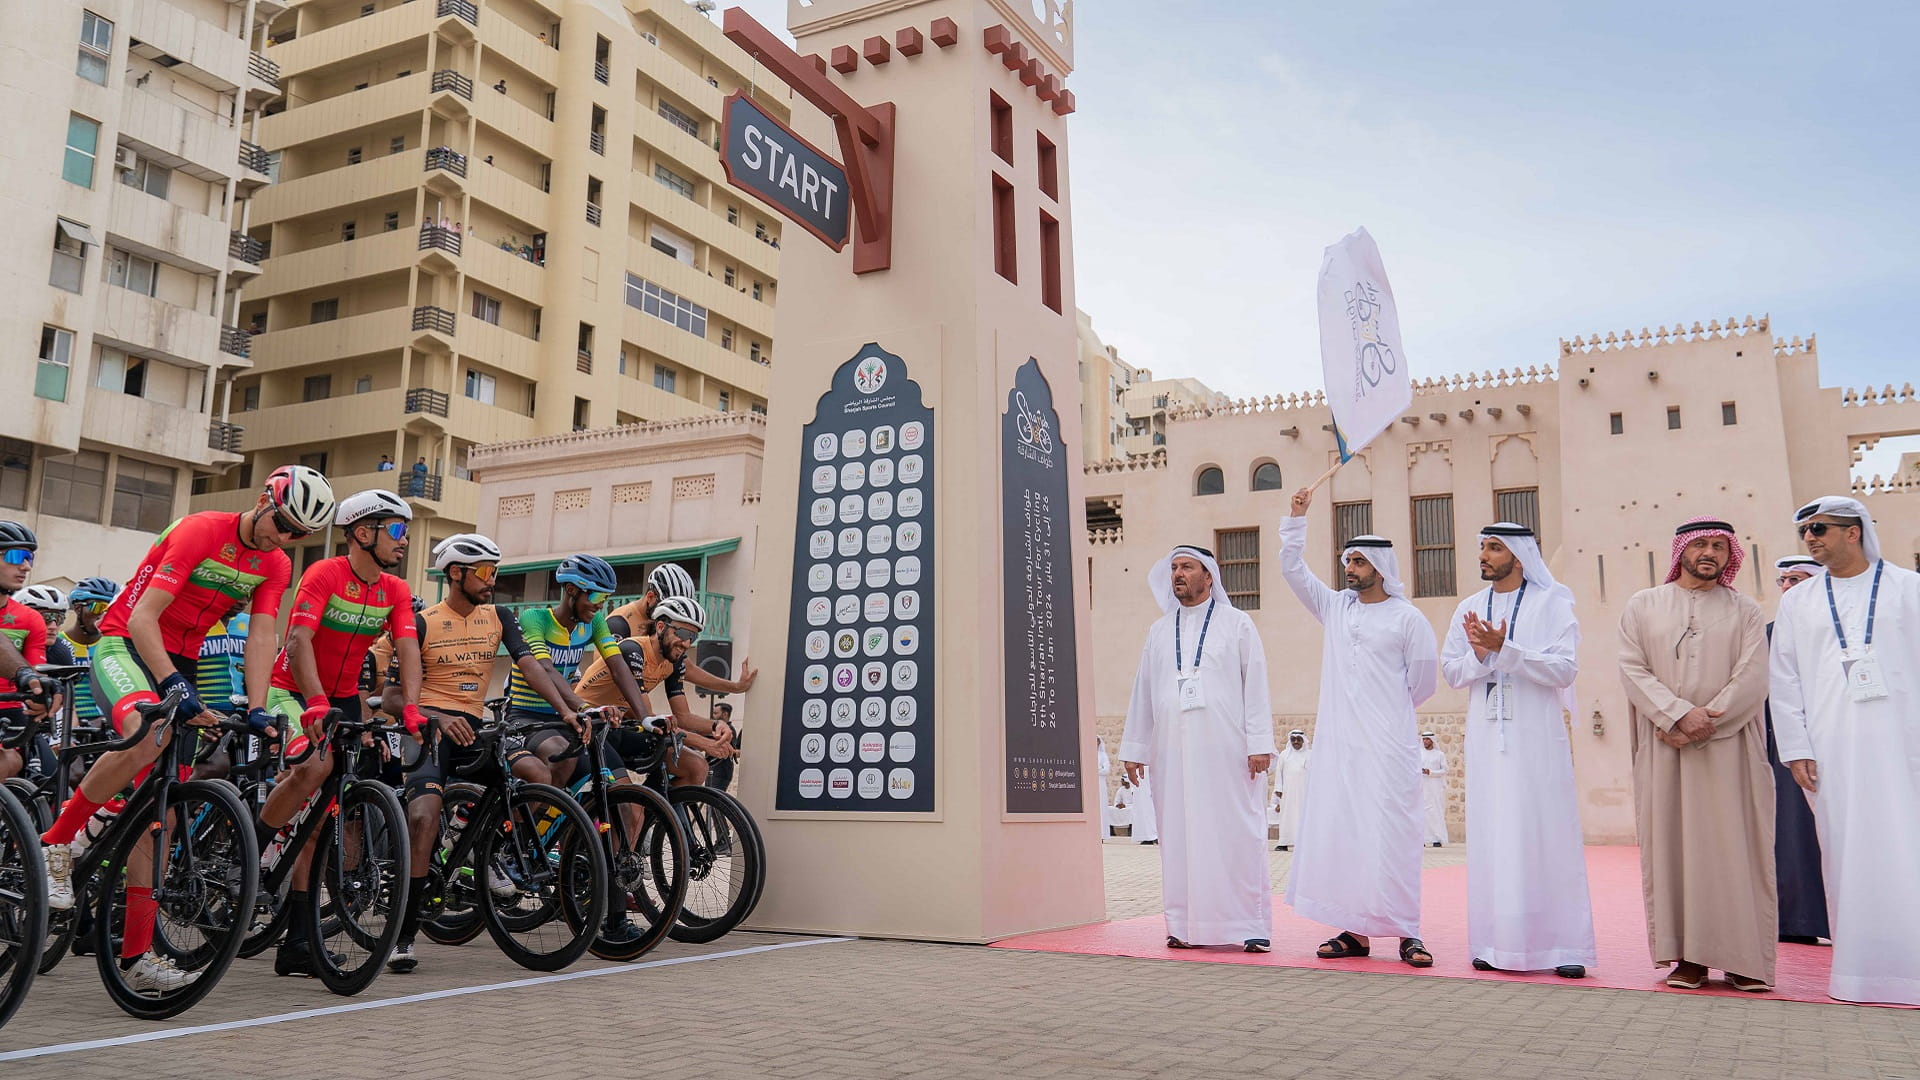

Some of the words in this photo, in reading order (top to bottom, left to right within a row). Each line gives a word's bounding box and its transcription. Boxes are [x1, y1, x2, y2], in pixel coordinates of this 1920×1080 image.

[741, 124, 838, 220] START
[878, 401, 896, 409] Council
[1024, 488, 1032, 528] طواف
[1042, 495, 1049, 512] 26
[1025, 530, 1033, 582] الشارقة
[1043, 542, 1051, 557] 31
[126, 564, 154, 609] MOROCCO
[1026, 585, 1036, 628] الدولي
[1045, 593, 1053, 628] 2024
[325, 607, 387, 628] MOROCC
[198, 638, 246, 656] RWAND
[546, 646, 585, 665] WAND
[437, 654, 453, 664] AL
[1038, 643, 1046, 699] Sharjah
[1048, 668, 1055, 684] 31
[1029, 673, 1037, 727] للدراجات
[1048, 689, 1055, 706] To
[1049, 711, 1056, 729] 26
